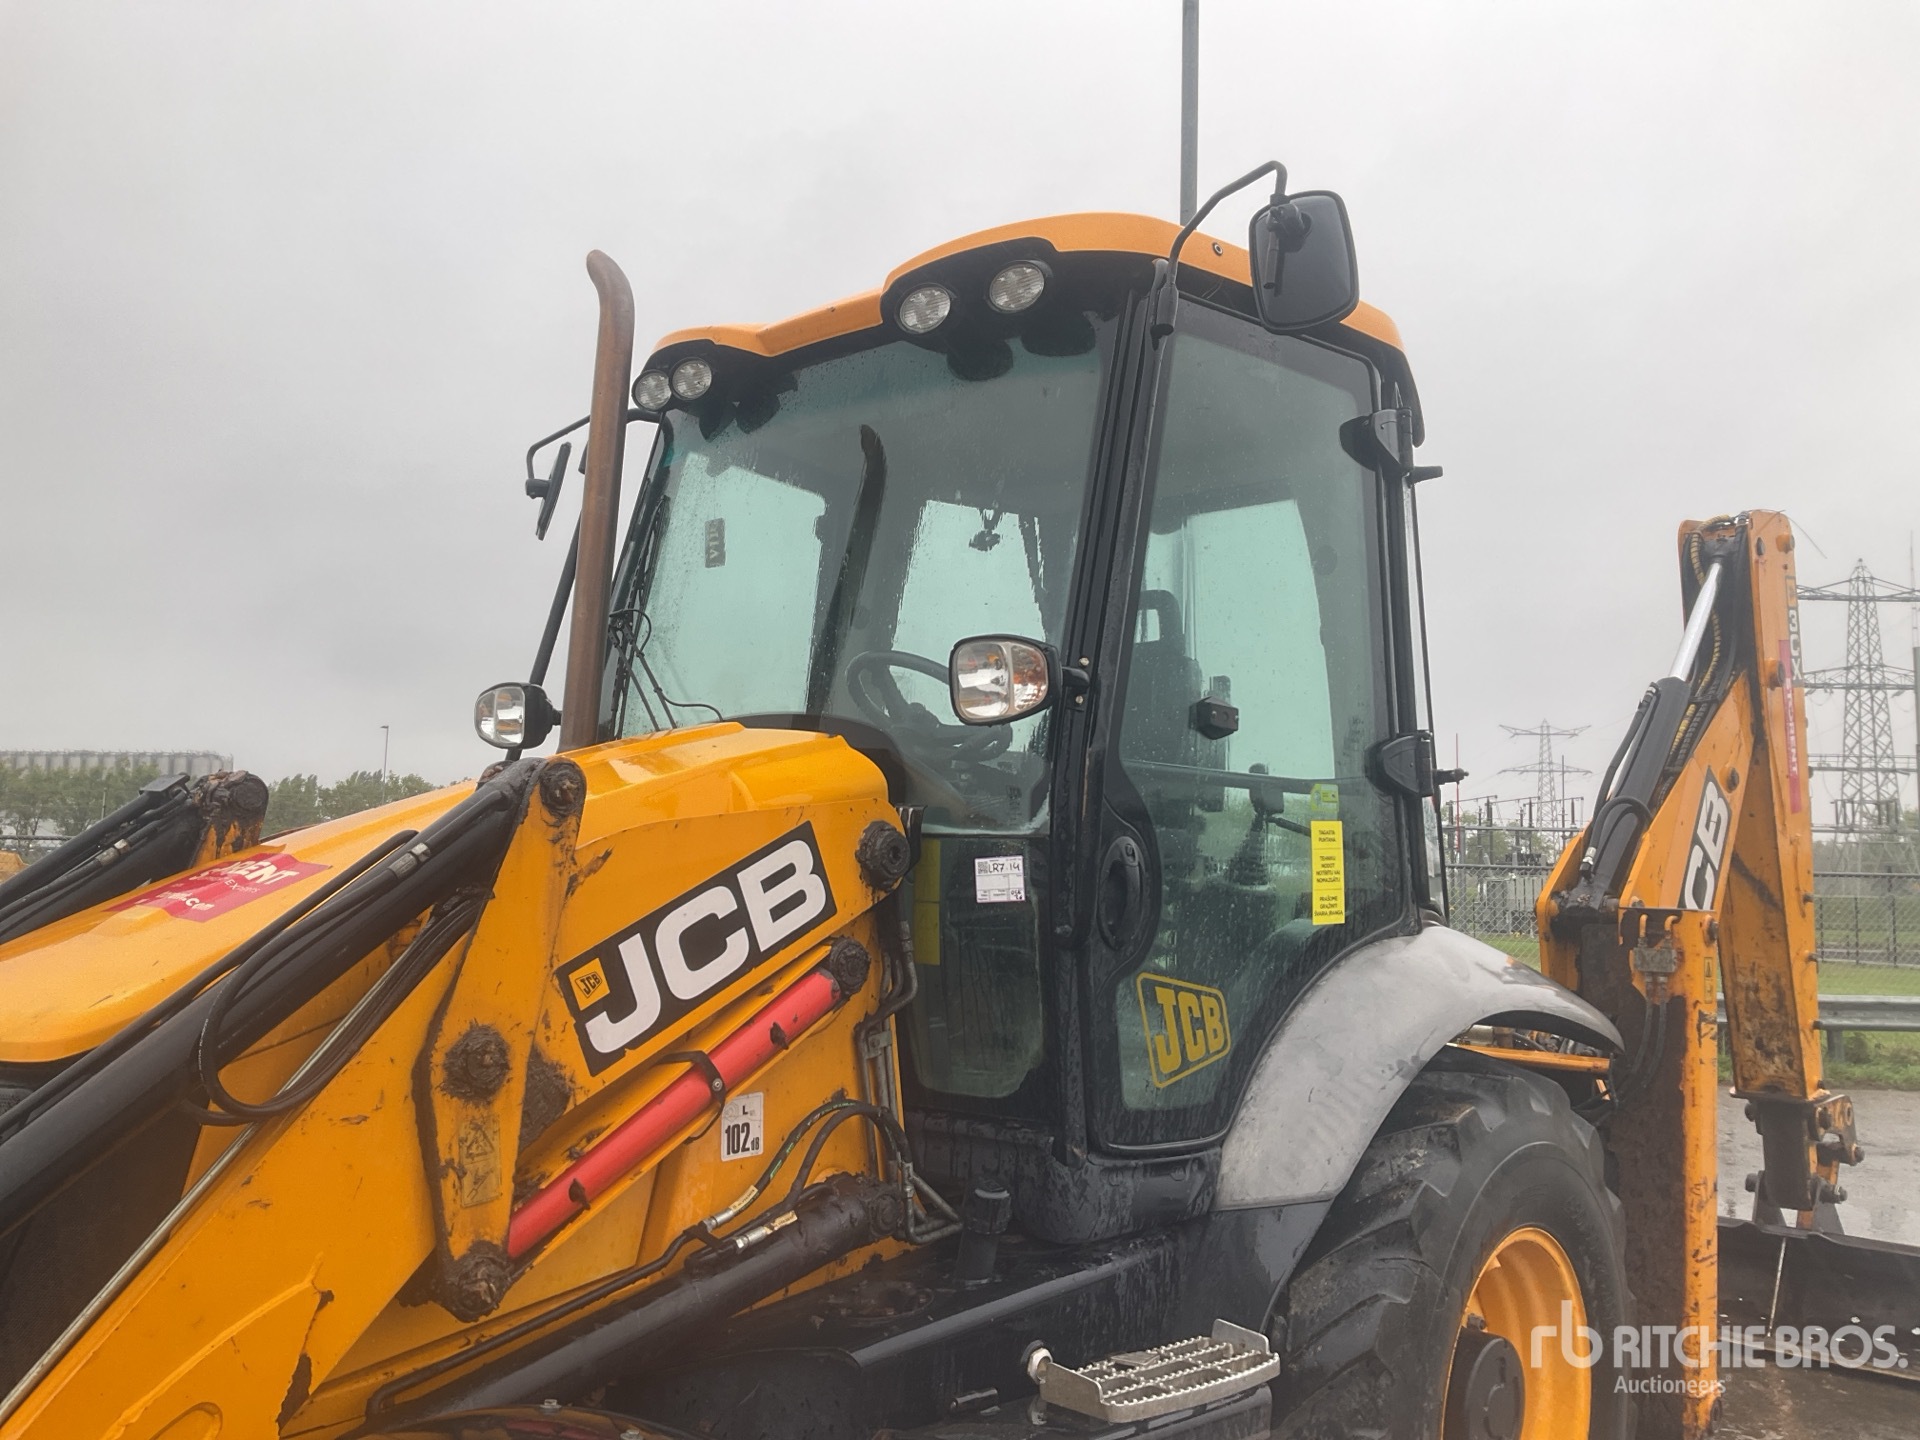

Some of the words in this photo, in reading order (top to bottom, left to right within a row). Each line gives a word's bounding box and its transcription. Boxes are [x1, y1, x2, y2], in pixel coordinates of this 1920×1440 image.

[585, 840, 827, 1054] JCB
[579, 973, 601, 995] JCB
[1154, 986, 1225, 1075] JCB
[725, 1122, 751, 1156] 102
